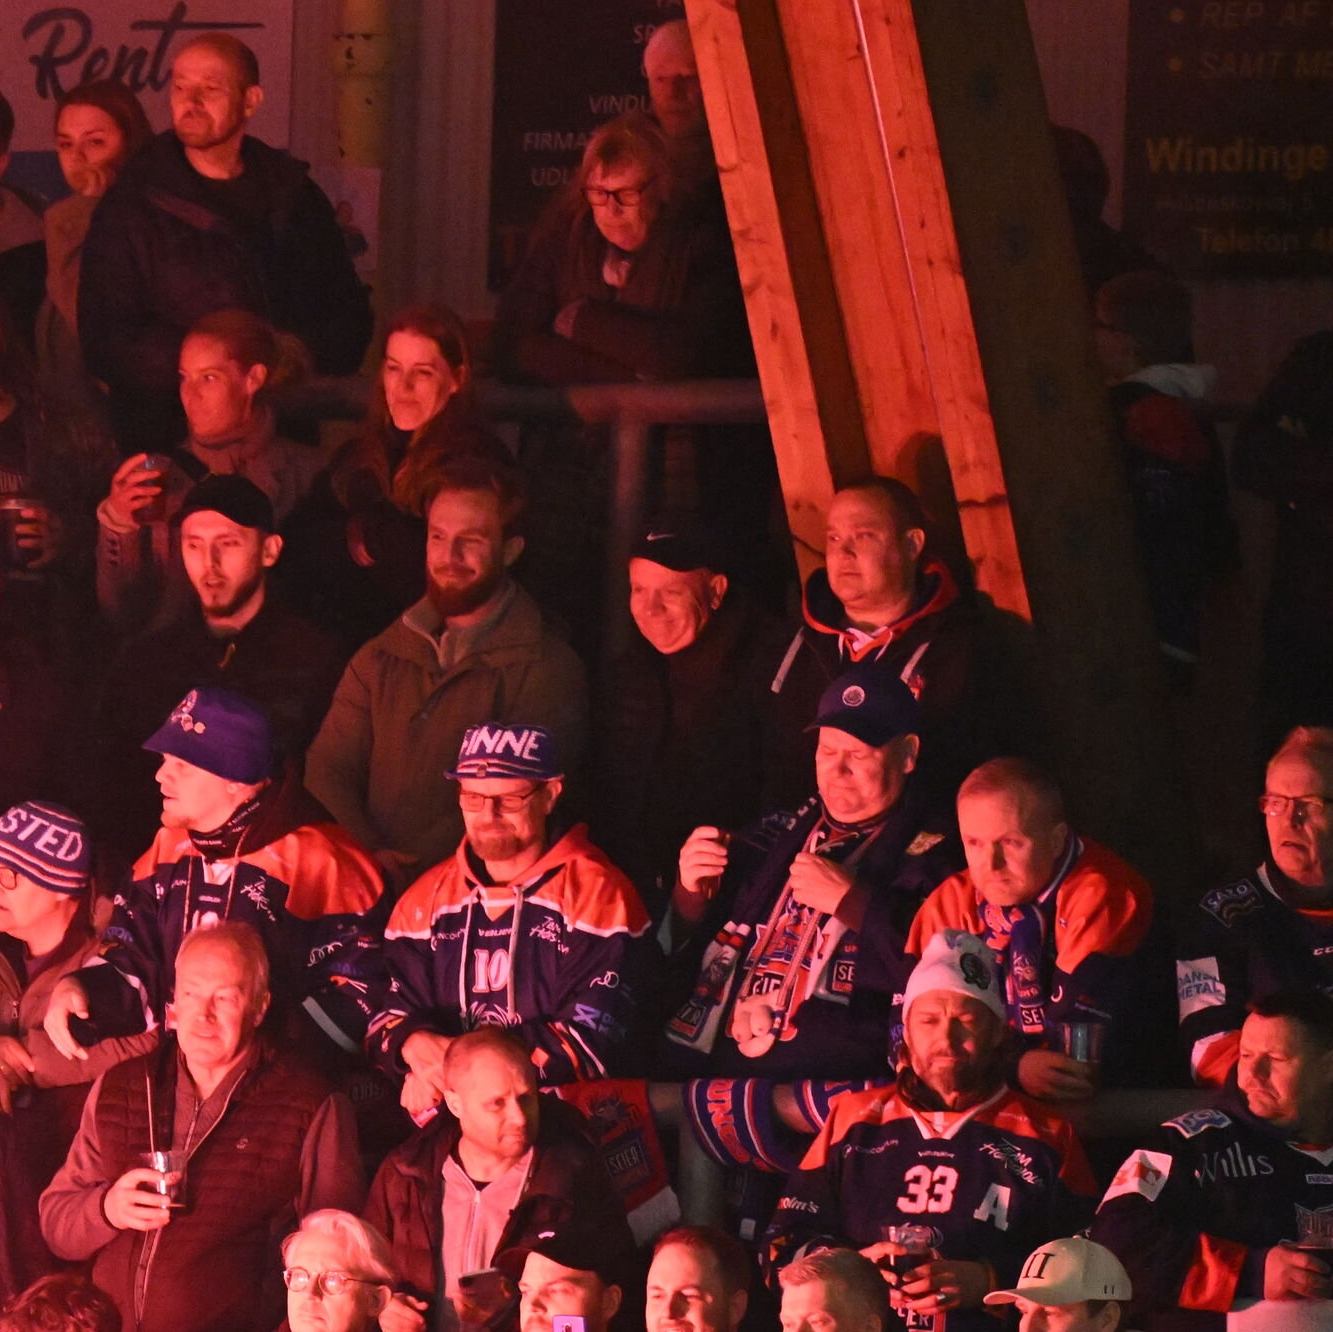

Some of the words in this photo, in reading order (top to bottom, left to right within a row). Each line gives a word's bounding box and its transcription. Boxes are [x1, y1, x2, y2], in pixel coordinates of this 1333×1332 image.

[23, 2, 263, 98] Rent
[588, 94, 654, 115] VINDU
[523, 131, 593, 151] FIRMA
[1145, 135, 1329, 183] Windinge
[472, 947, 510, 993] 10
[896, 1164, 959, 1215] 33
[973, 1182, 1012, 1231] A
